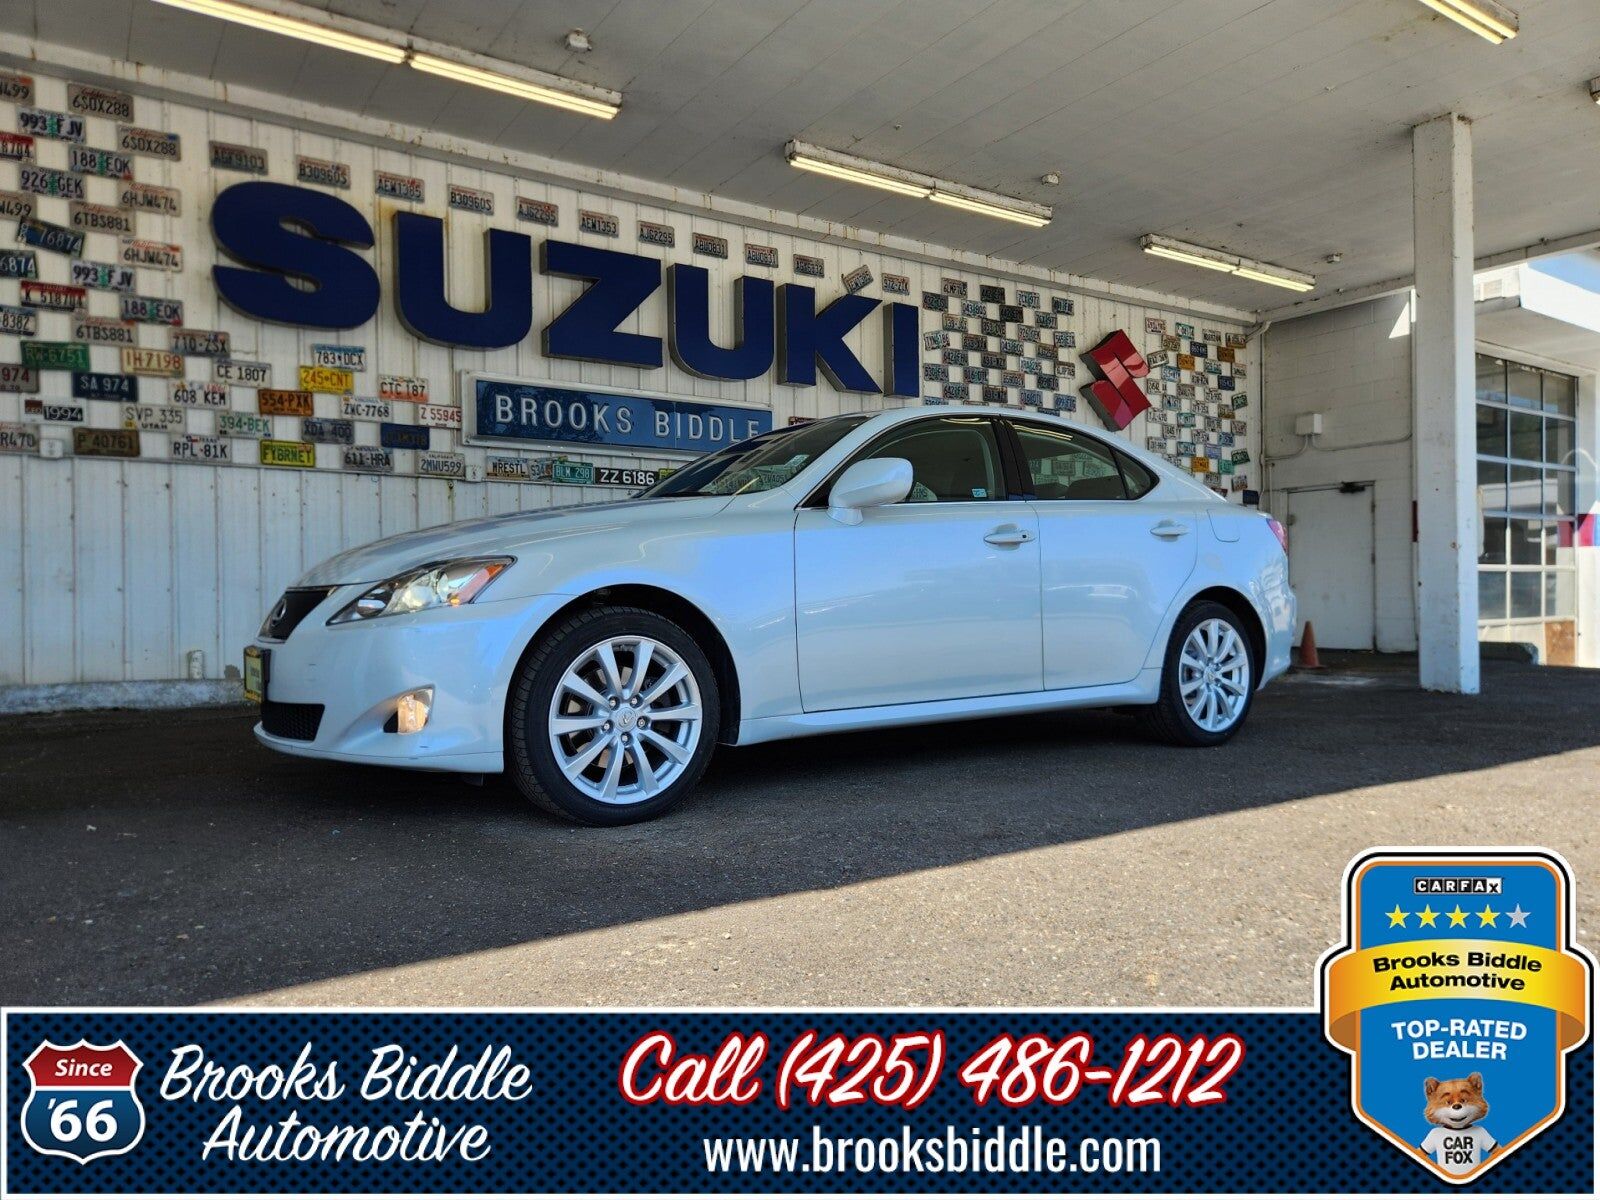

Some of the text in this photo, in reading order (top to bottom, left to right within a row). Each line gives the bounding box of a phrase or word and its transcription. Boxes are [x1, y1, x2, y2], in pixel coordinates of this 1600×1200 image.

[0, 83, 30, 100] 499
[73, 150, 97, 169] 188
[21, 169, 48, 189] 926
[210, 181, 920, 399] SUZUKI
[217, 365, 267, 382] CE 1807
[44, 405, 83, 421] 1994
[494, 393, 760, 444] BROOKS BIDDLE
[600, 469, 619, 484] ZZ
[622, 470, 655, 485] 6186
